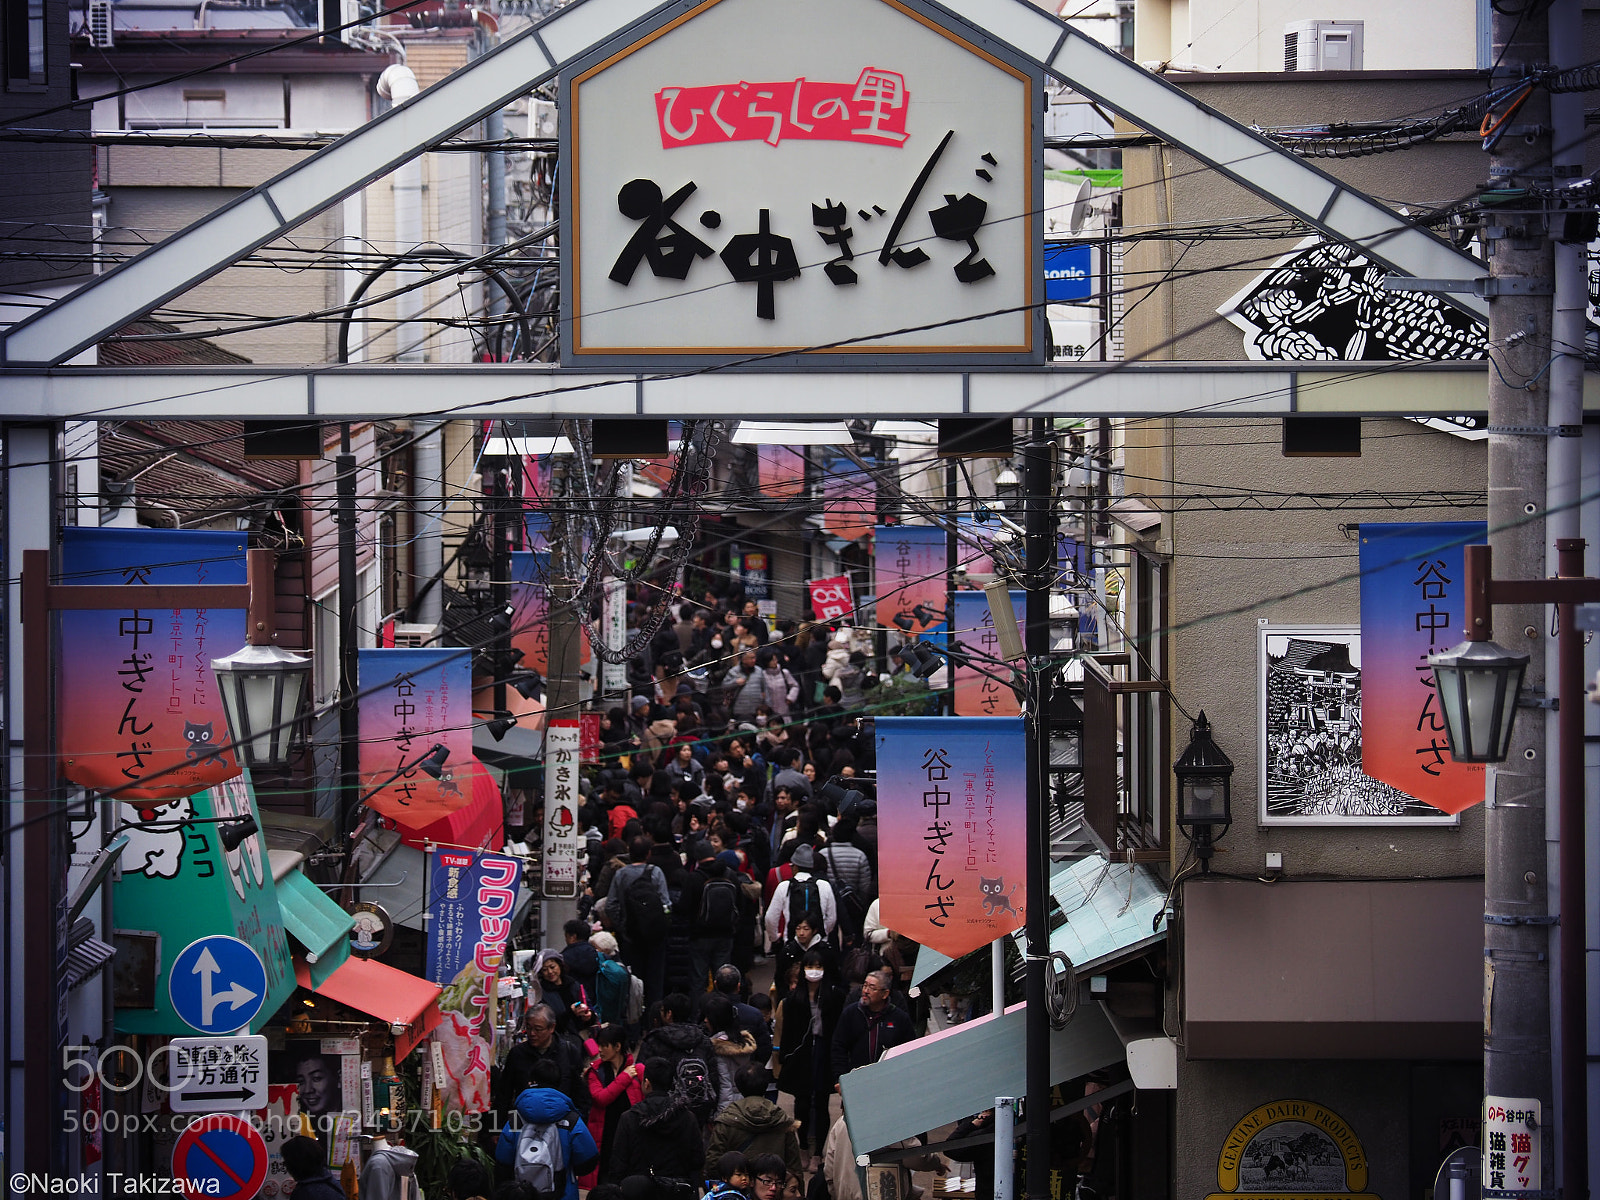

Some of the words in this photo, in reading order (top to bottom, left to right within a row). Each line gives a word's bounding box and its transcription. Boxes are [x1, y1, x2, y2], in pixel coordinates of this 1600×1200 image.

[662, 67, 910, 146] ひぐらしの里
[608, 130, 997, 320] 谷中ぎんざ
[117, 565, 154, 780] 谷中ぎんざ
[166, 608, 184, 715] 東京下町レトロ』
[193, 561, 209, 705] 人と史がすぐそこに
[393, 672, 417, 806] 谷中ぎんざ
[555, 748, 571, 801] かき氷
[920, 748, 955, 928] 谷中ぎんざ
[963, 772, 978, 873] 『東京下町レトロ』
[983, 740, 997, 863] 人と歴史がすぐそこに
[177, 1045, 259, 1065] 自転車を除く
[177, 1065, 259, 1086] 一方通行
[1222, 1114, 1263, 1171] GENUINE
[1266, 1104, 1308, 1120] DAIRY
[1314, 1109, 1363, 1171] PRODUCTS
[1490, 1132, 1506, 1189] 猫雑貨
[1511, 1133, 1532, 1190] 猫グッ
